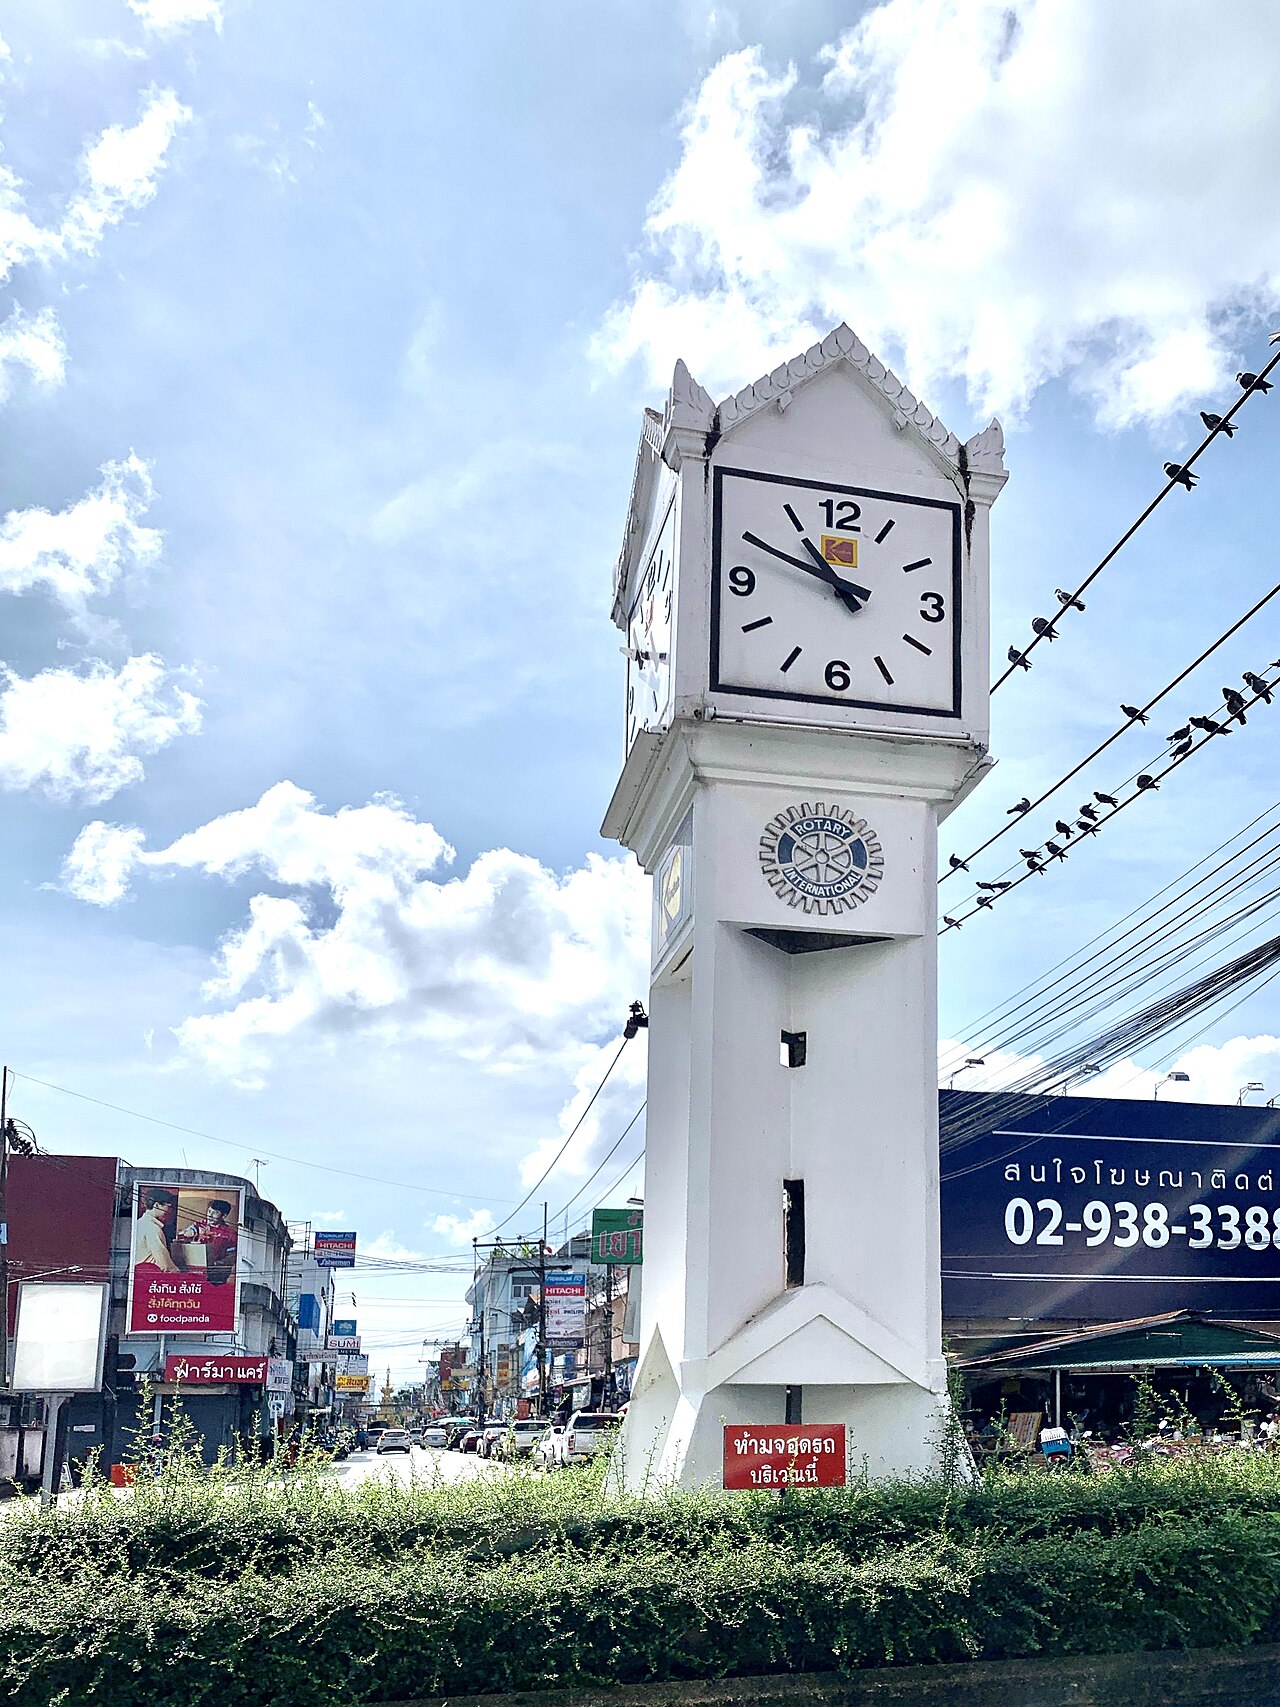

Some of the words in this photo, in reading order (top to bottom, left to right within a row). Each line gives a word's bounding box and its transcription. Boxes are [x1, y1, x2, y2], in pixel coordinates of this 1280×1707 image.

[819, 499, 861, 532] 12
[728, 566, 756, 596] 9
[919, 592, 945, 622] 3
[824, 660, 851, 691] 6
[795, 819, 851, 838] ROTARY
[785, 868, 861, 897] INTERNATIONAL
[148, 1281, 176, 1294] สั่งกิน
[179, 1281, 202, 1294] สั่งใช้
[545, 1287, 581, 1295] HITACHI
[148, 1296, 200, 1311] สั่งได้ทุกวัน
[160, 1314, 210, 1324] foodpanda
[329, 1339, 359, 1348] SUMI
[173, 1361, 233, 1379] ฟาร์มา
[237, 1362, 266, 1379] แคร์
[734, 1431, 835, 1455] ห้ามจอดรถ
